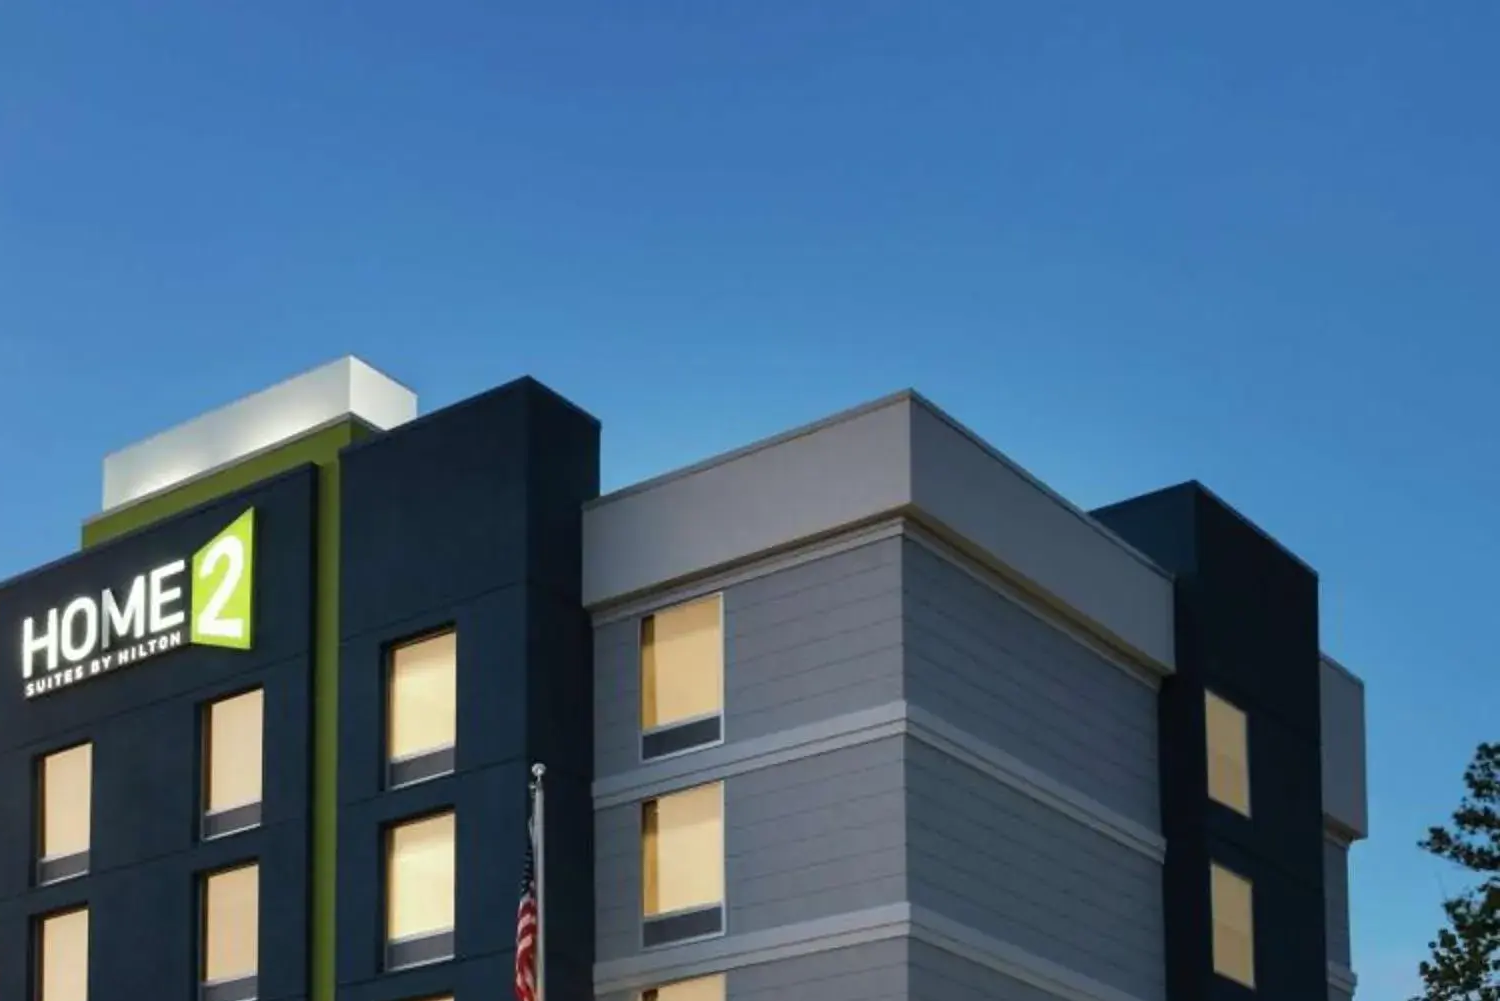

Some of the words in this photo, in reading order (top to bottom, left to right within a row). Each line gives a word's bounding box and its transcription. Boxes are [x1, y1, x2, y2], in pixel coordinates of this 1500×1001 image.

[22, 559, 185, 679] HOME
[196, 534, 244, 639] 2
[25, 666, 84, 698] SUITES
[90, 654, 112, 675] BY
[117, 630, 182, 664] HILTON
